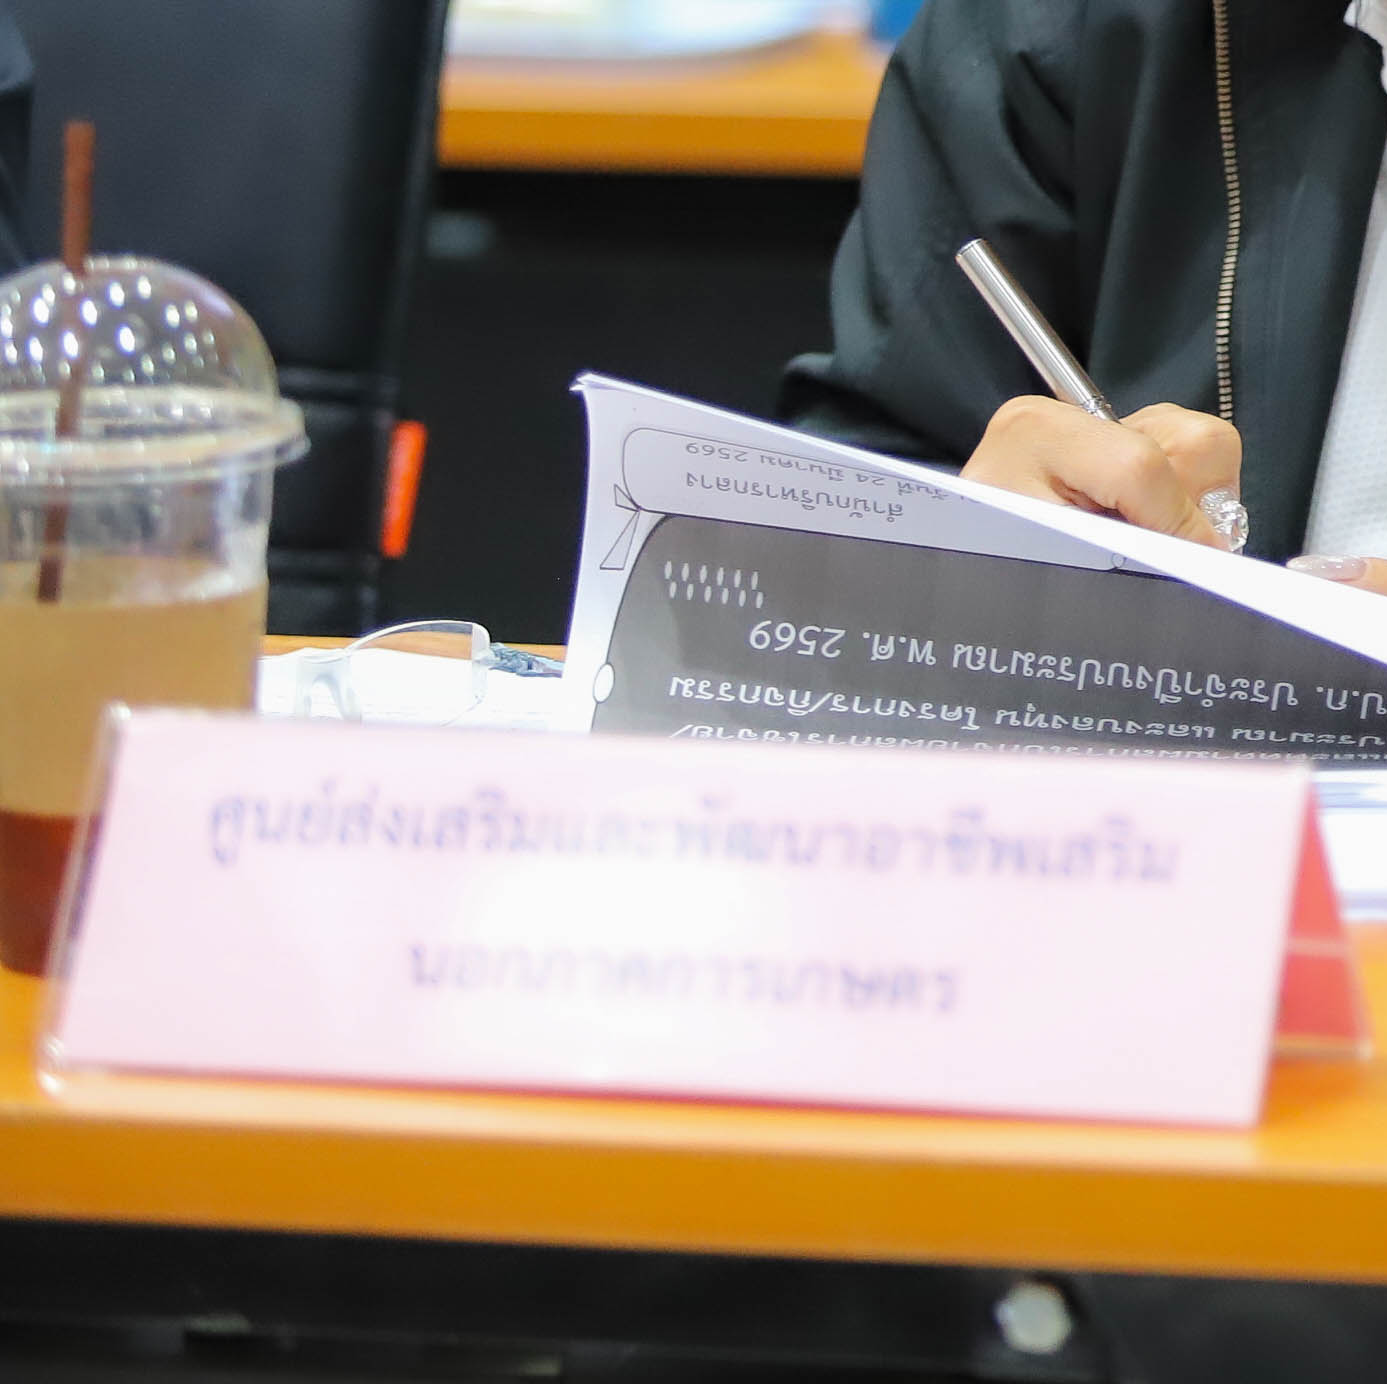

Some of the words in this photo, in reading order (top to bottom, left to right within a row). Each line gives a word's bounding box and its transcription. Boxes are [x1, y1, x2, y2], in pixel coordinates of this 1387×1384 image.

[685, 441, 748, 464] 2569
[759, 453, 844, 483] มีนาคม
[685, 472, 904, 523] สำนักบริหารกลาง
[855, 473, 885, 487] 24
[748, 620, 847, 658] 2569
[862, 631, 937, 666] พ.ศ.
[953, 643, 1299, 711] ประจำปีงบประมาณ
[668, 676, 980, 730] โครงการ/กิจกรรม
[995, 702, 1216, 741] และงบลงทุน
